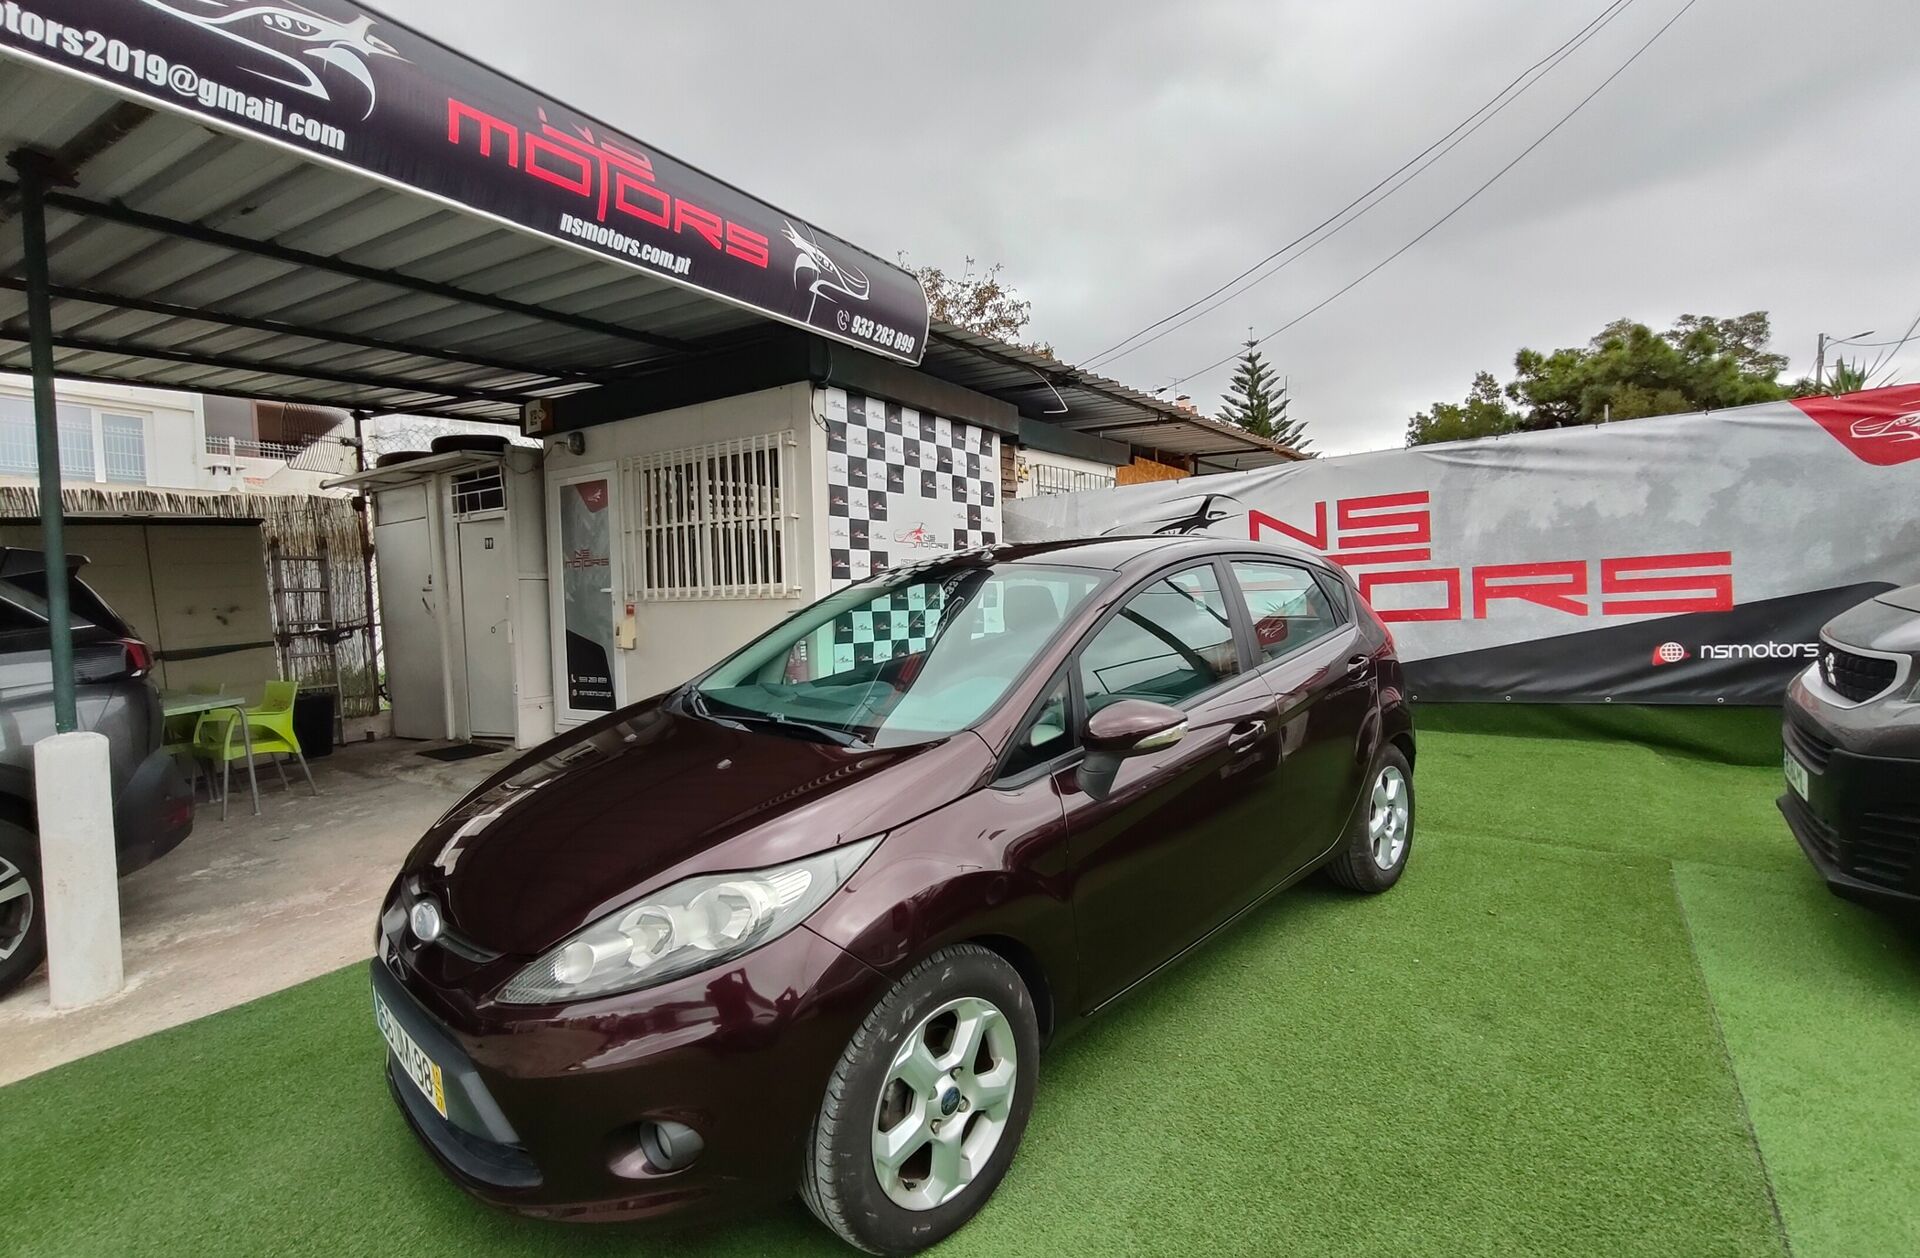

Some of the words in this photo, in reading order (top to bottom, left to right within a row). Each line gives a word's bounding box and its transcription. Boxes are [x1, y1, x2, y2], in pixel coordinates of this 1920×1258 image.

[0, 1, 346, 151] tors2019@gmail.com
[448, 97, 769, 268] MOTORS
[560, 213, 691, 275] nsmotors.com.pt
[851, 315, 875, 339] 933
[873, 323, 895, 346] 283
[894, 331, 915, 354] 899
[1249, 490, 1432, 550] NS
[1700, 640, 1819, 659] nsmotors
